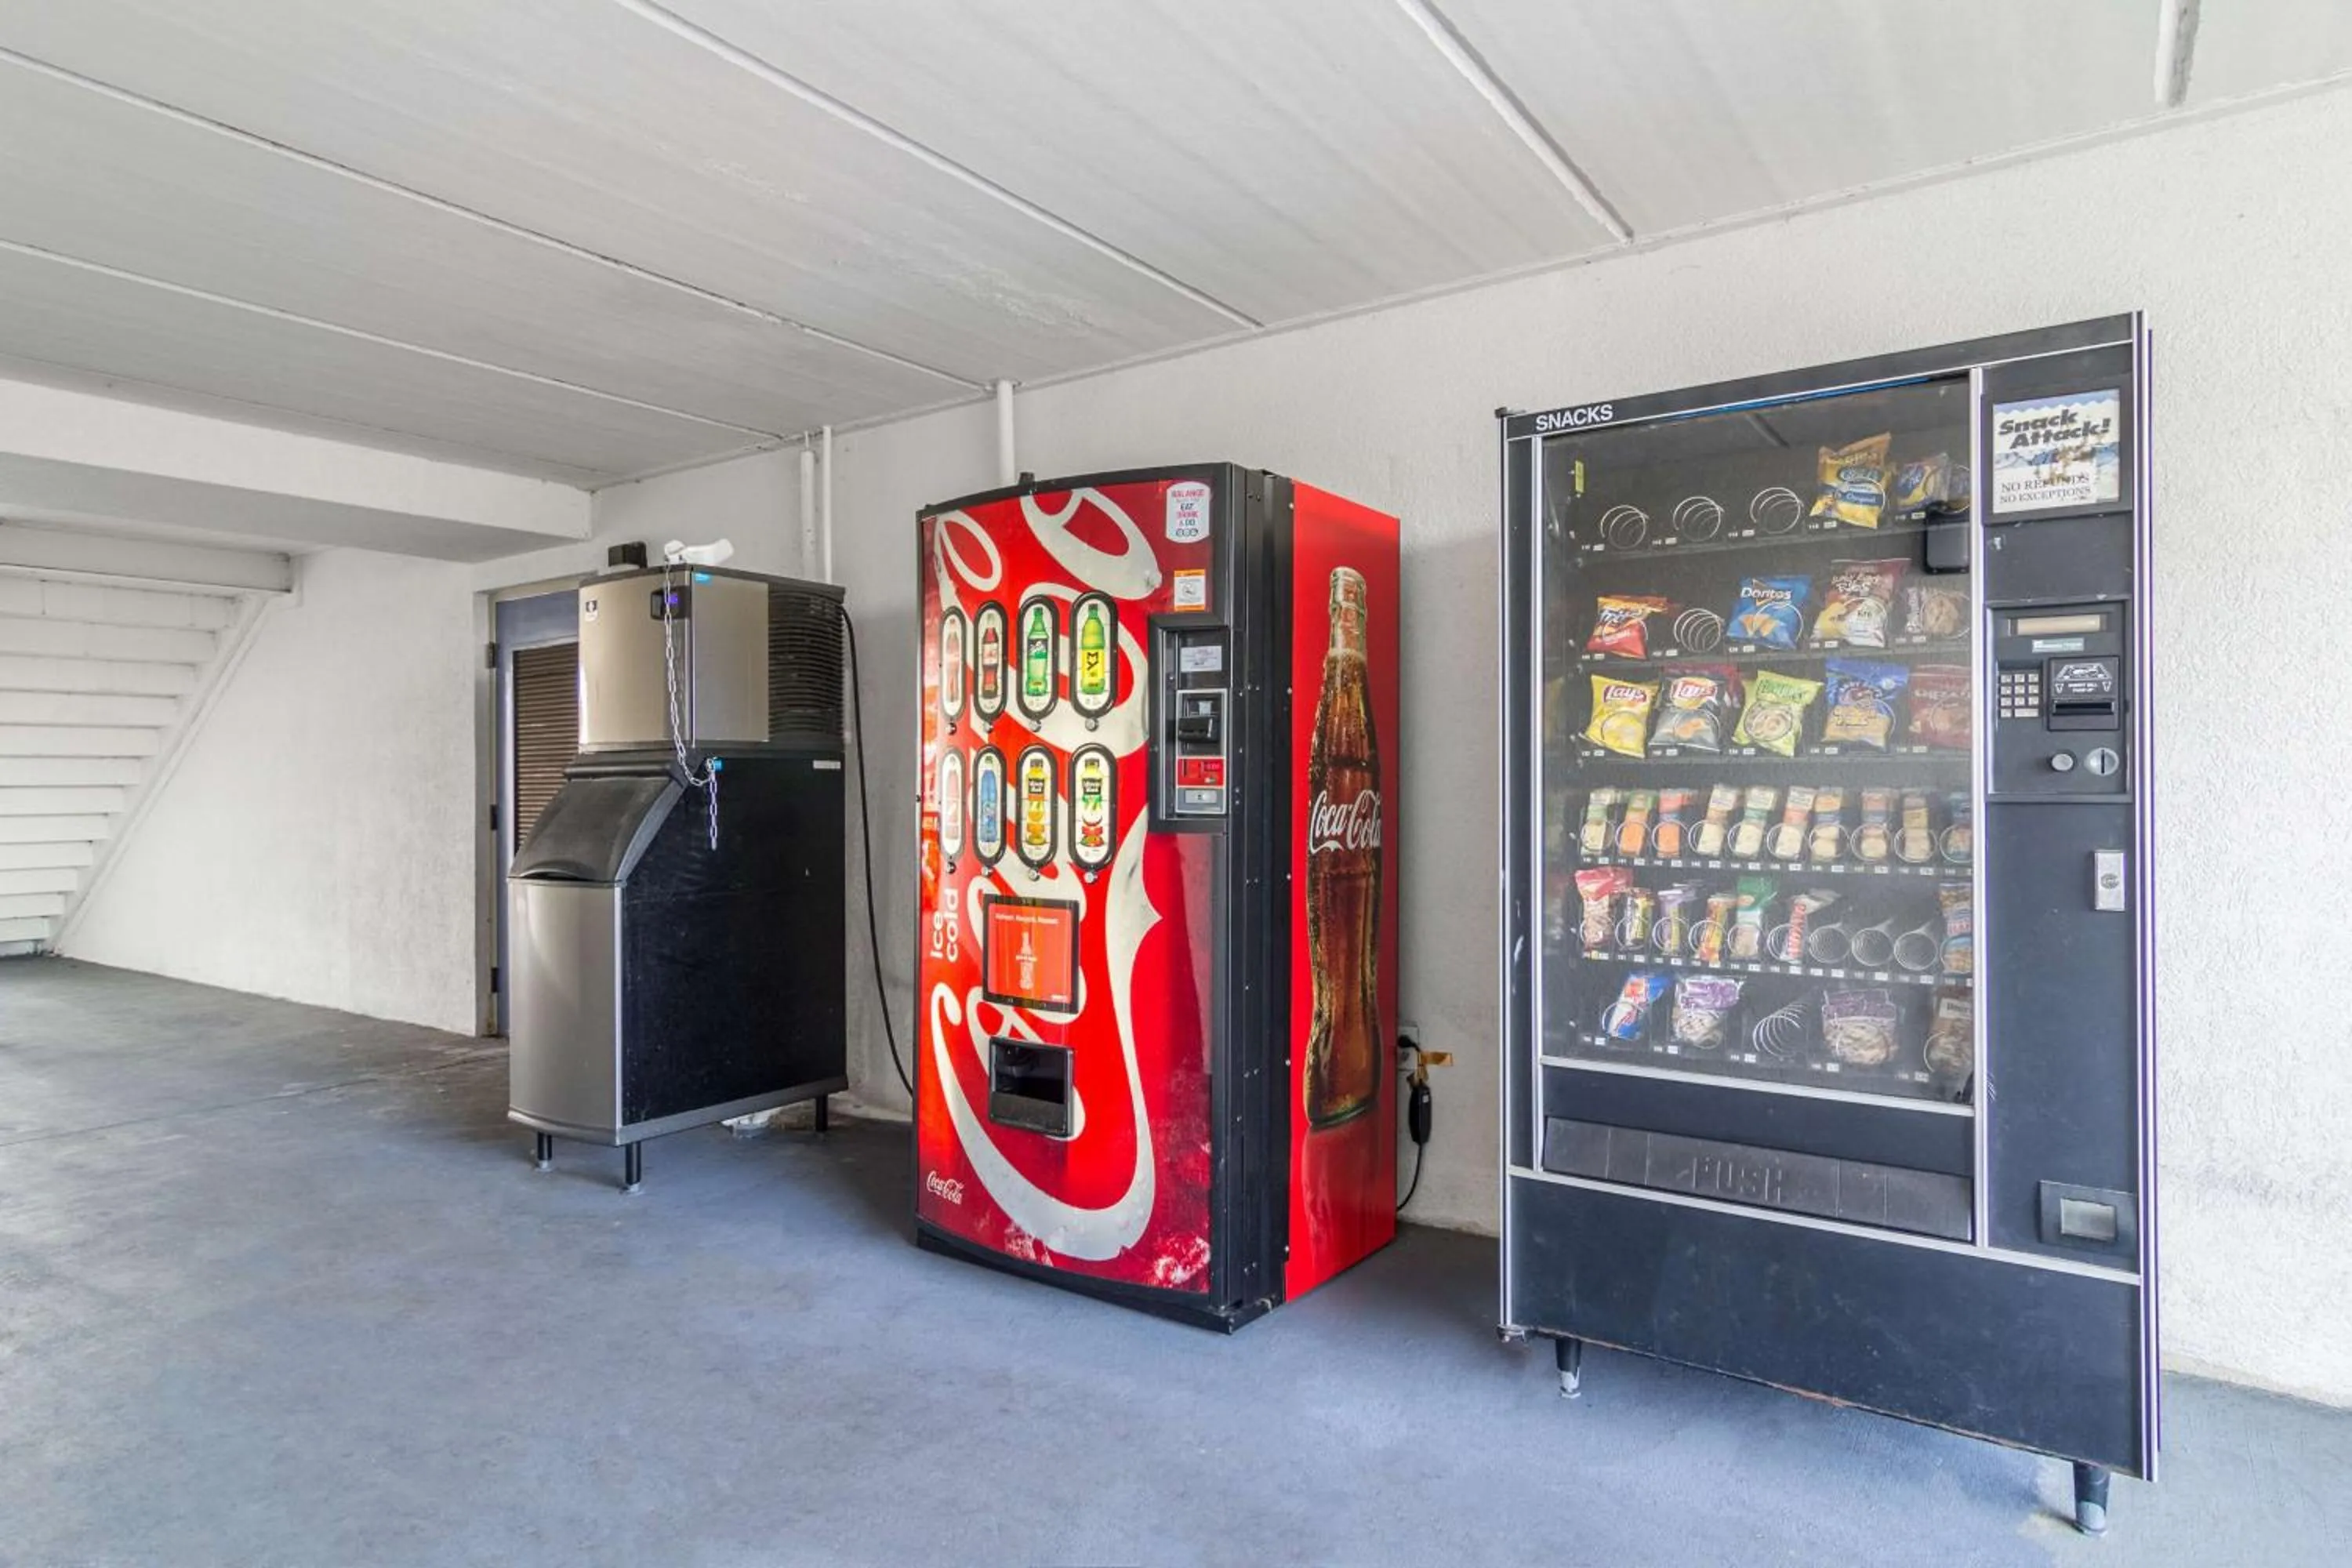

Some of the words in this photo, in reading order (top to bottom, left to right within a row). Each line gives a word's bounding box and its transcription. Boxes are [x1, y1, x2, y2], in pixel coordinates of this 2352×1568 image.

[1535, 404, 1613, 431] SNACKS
[1998, 408, 2078, 436] Snack
[2009, 418, 2112, 449] Attack!
[2000, 494, 2016, 503] NO
[2019, 487, 2091, 502] EXCEPTIONS
[2002, 481, 2020, 493] NO
[1740, 586, 1792, 600] Doritos
[930, 910, 943, 959] Ice
[944, 887, 959, 963] cold
[926, 1170, 964, 1205] Coca-Cola
